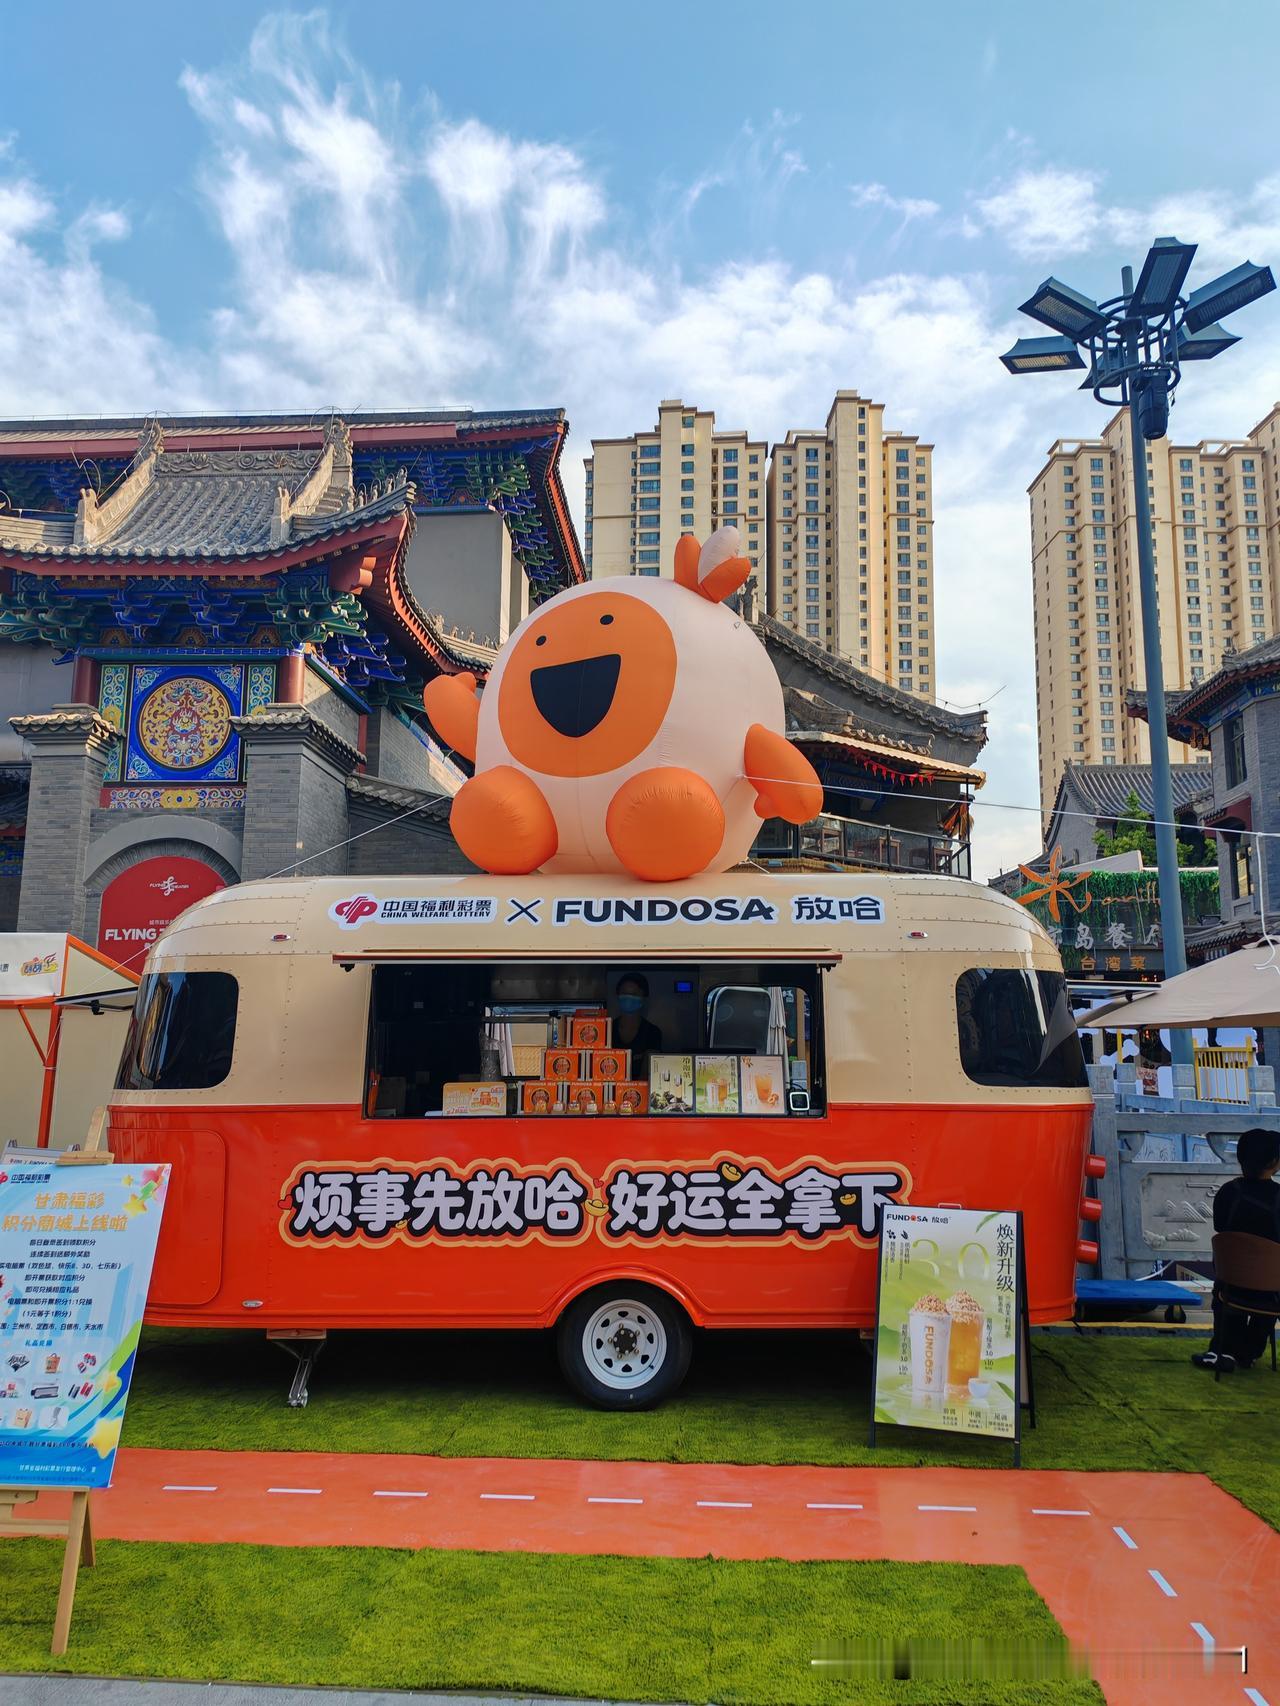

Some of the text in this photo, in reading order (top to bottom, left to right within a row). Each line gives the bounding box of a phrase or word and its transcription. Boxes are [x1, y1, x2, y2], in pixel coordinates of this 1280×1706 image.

[383, 899, 492, 912] 中国福利彩票
[556, 898, 775, 923] FUNDOSA
[795, 897, 881, 921] 放哈
[105, 928, 157, 941] FLYING
[35, 1191, 105, 1209] 甘肃福彩
[293, 1167, 898, 1233] 烦事先放哈 好运全拿下
[2, 1212, 128, 1232] 积分商城上线啦
[886, 1213, 929, 1222] FUNDOSA
[996, 1223, 1015, 1293] 焕新升级
